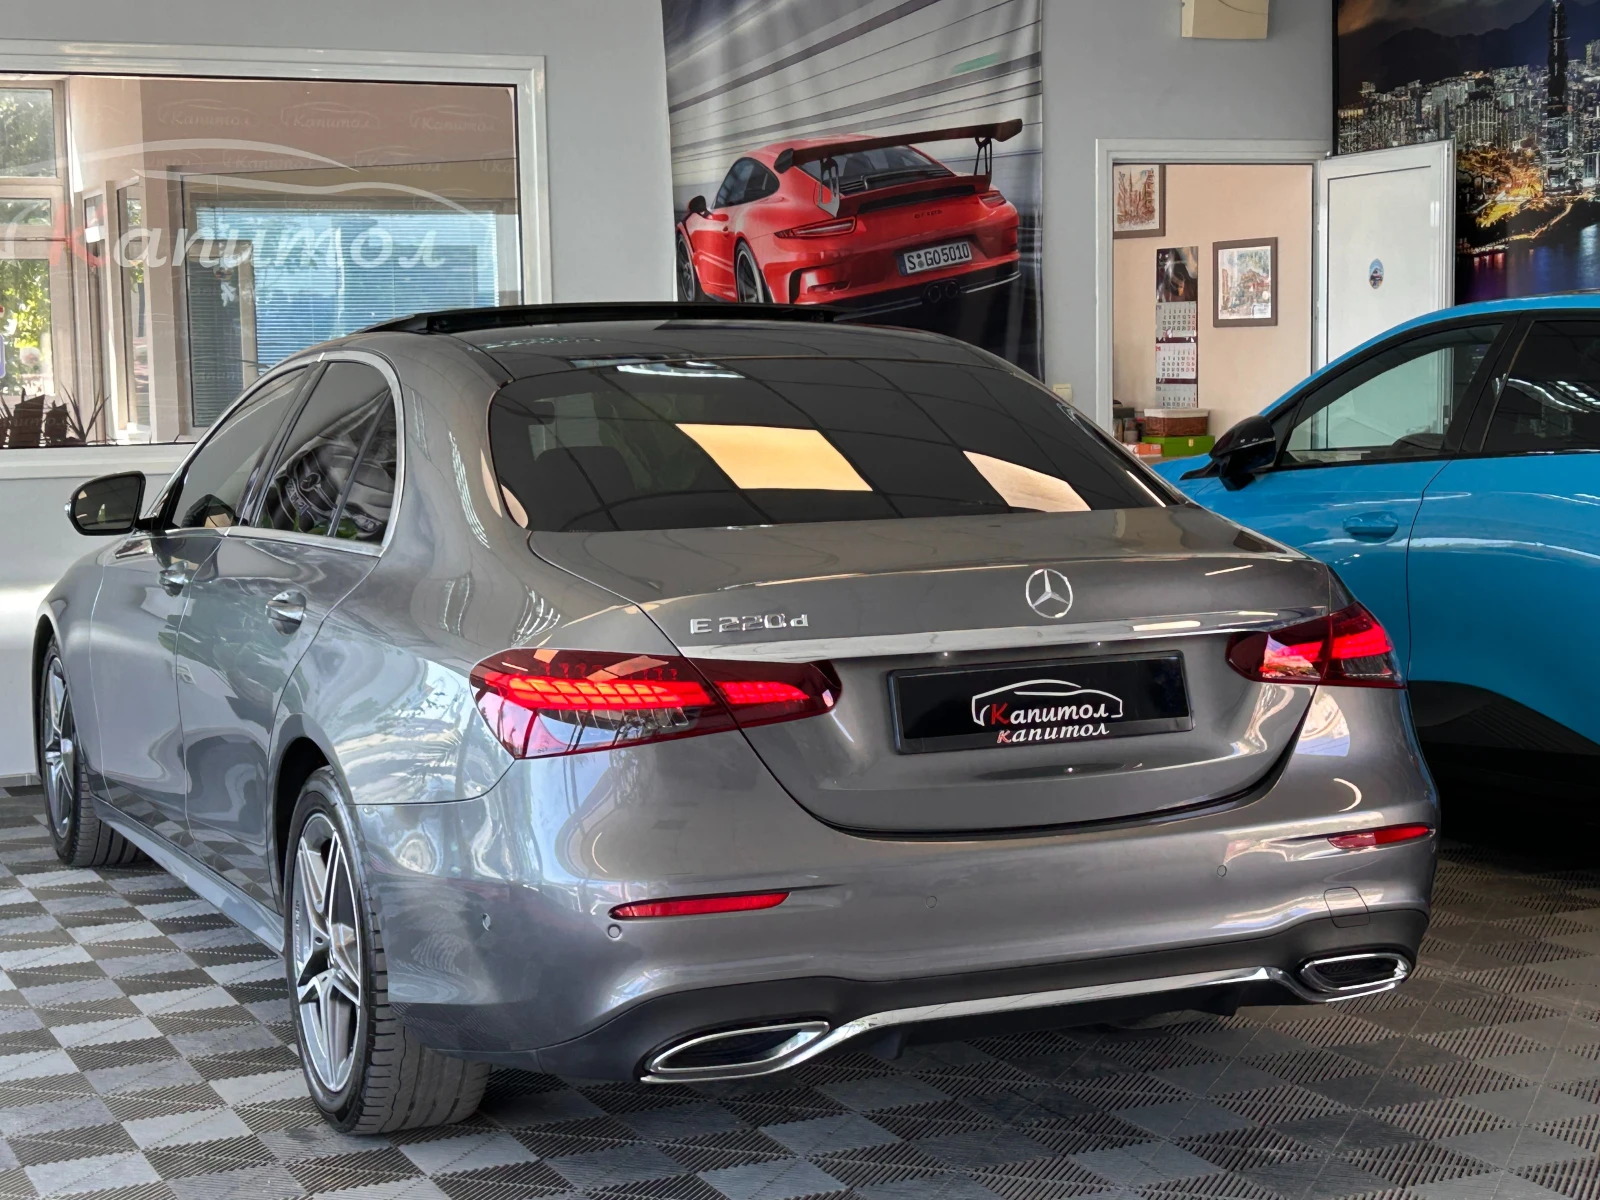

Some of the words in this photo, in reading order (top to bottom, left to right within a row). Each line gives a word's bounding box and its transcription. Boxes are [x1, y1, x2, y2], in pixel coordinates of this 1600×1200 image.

[47, 203, 446, 270] Капитол
[907, 254, 917, 270] S
[690, 618, 712, 635] E
[718, 612, 808, 632] 220d
[990, 702, 1109, 725] Капитол
